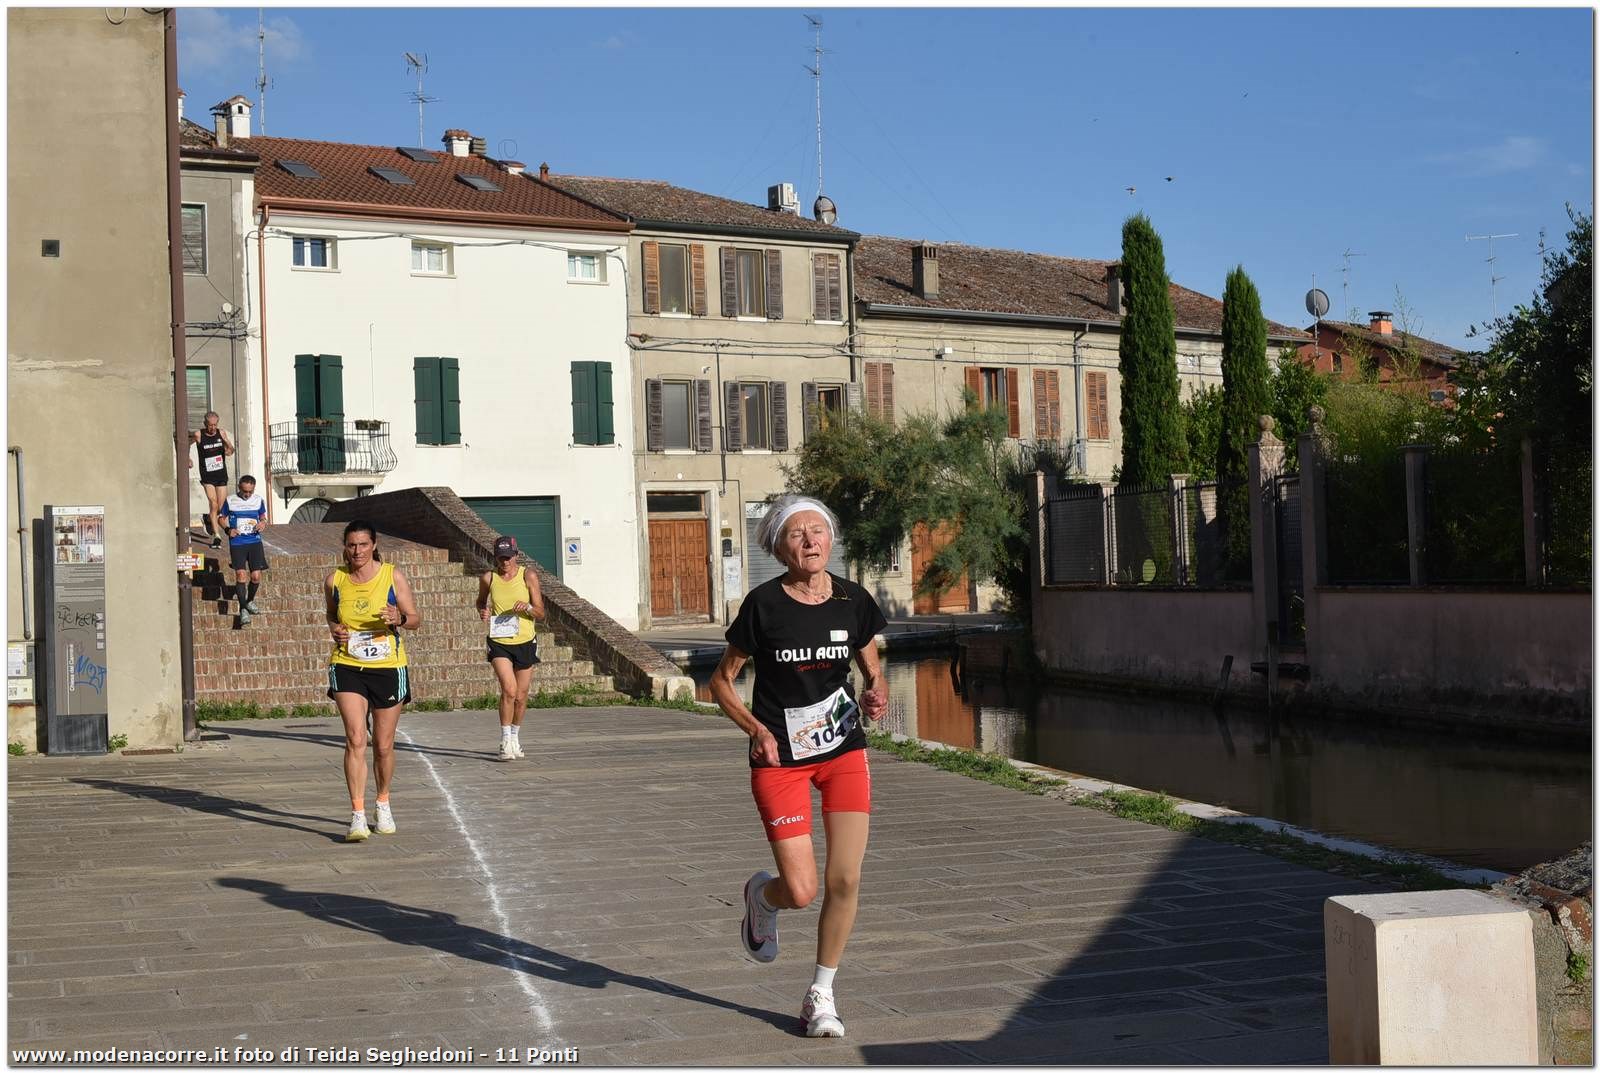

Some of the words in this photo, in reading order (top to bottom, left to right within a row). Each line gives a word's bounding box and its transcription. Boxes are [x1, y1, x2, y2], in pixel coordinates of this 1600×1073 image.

[363, 647, 378, 657] 12
[775, 648, 812, 662] LOLLI
[815, 645, 849, 660] AUTO
[811, 723, 847, 747] 104
